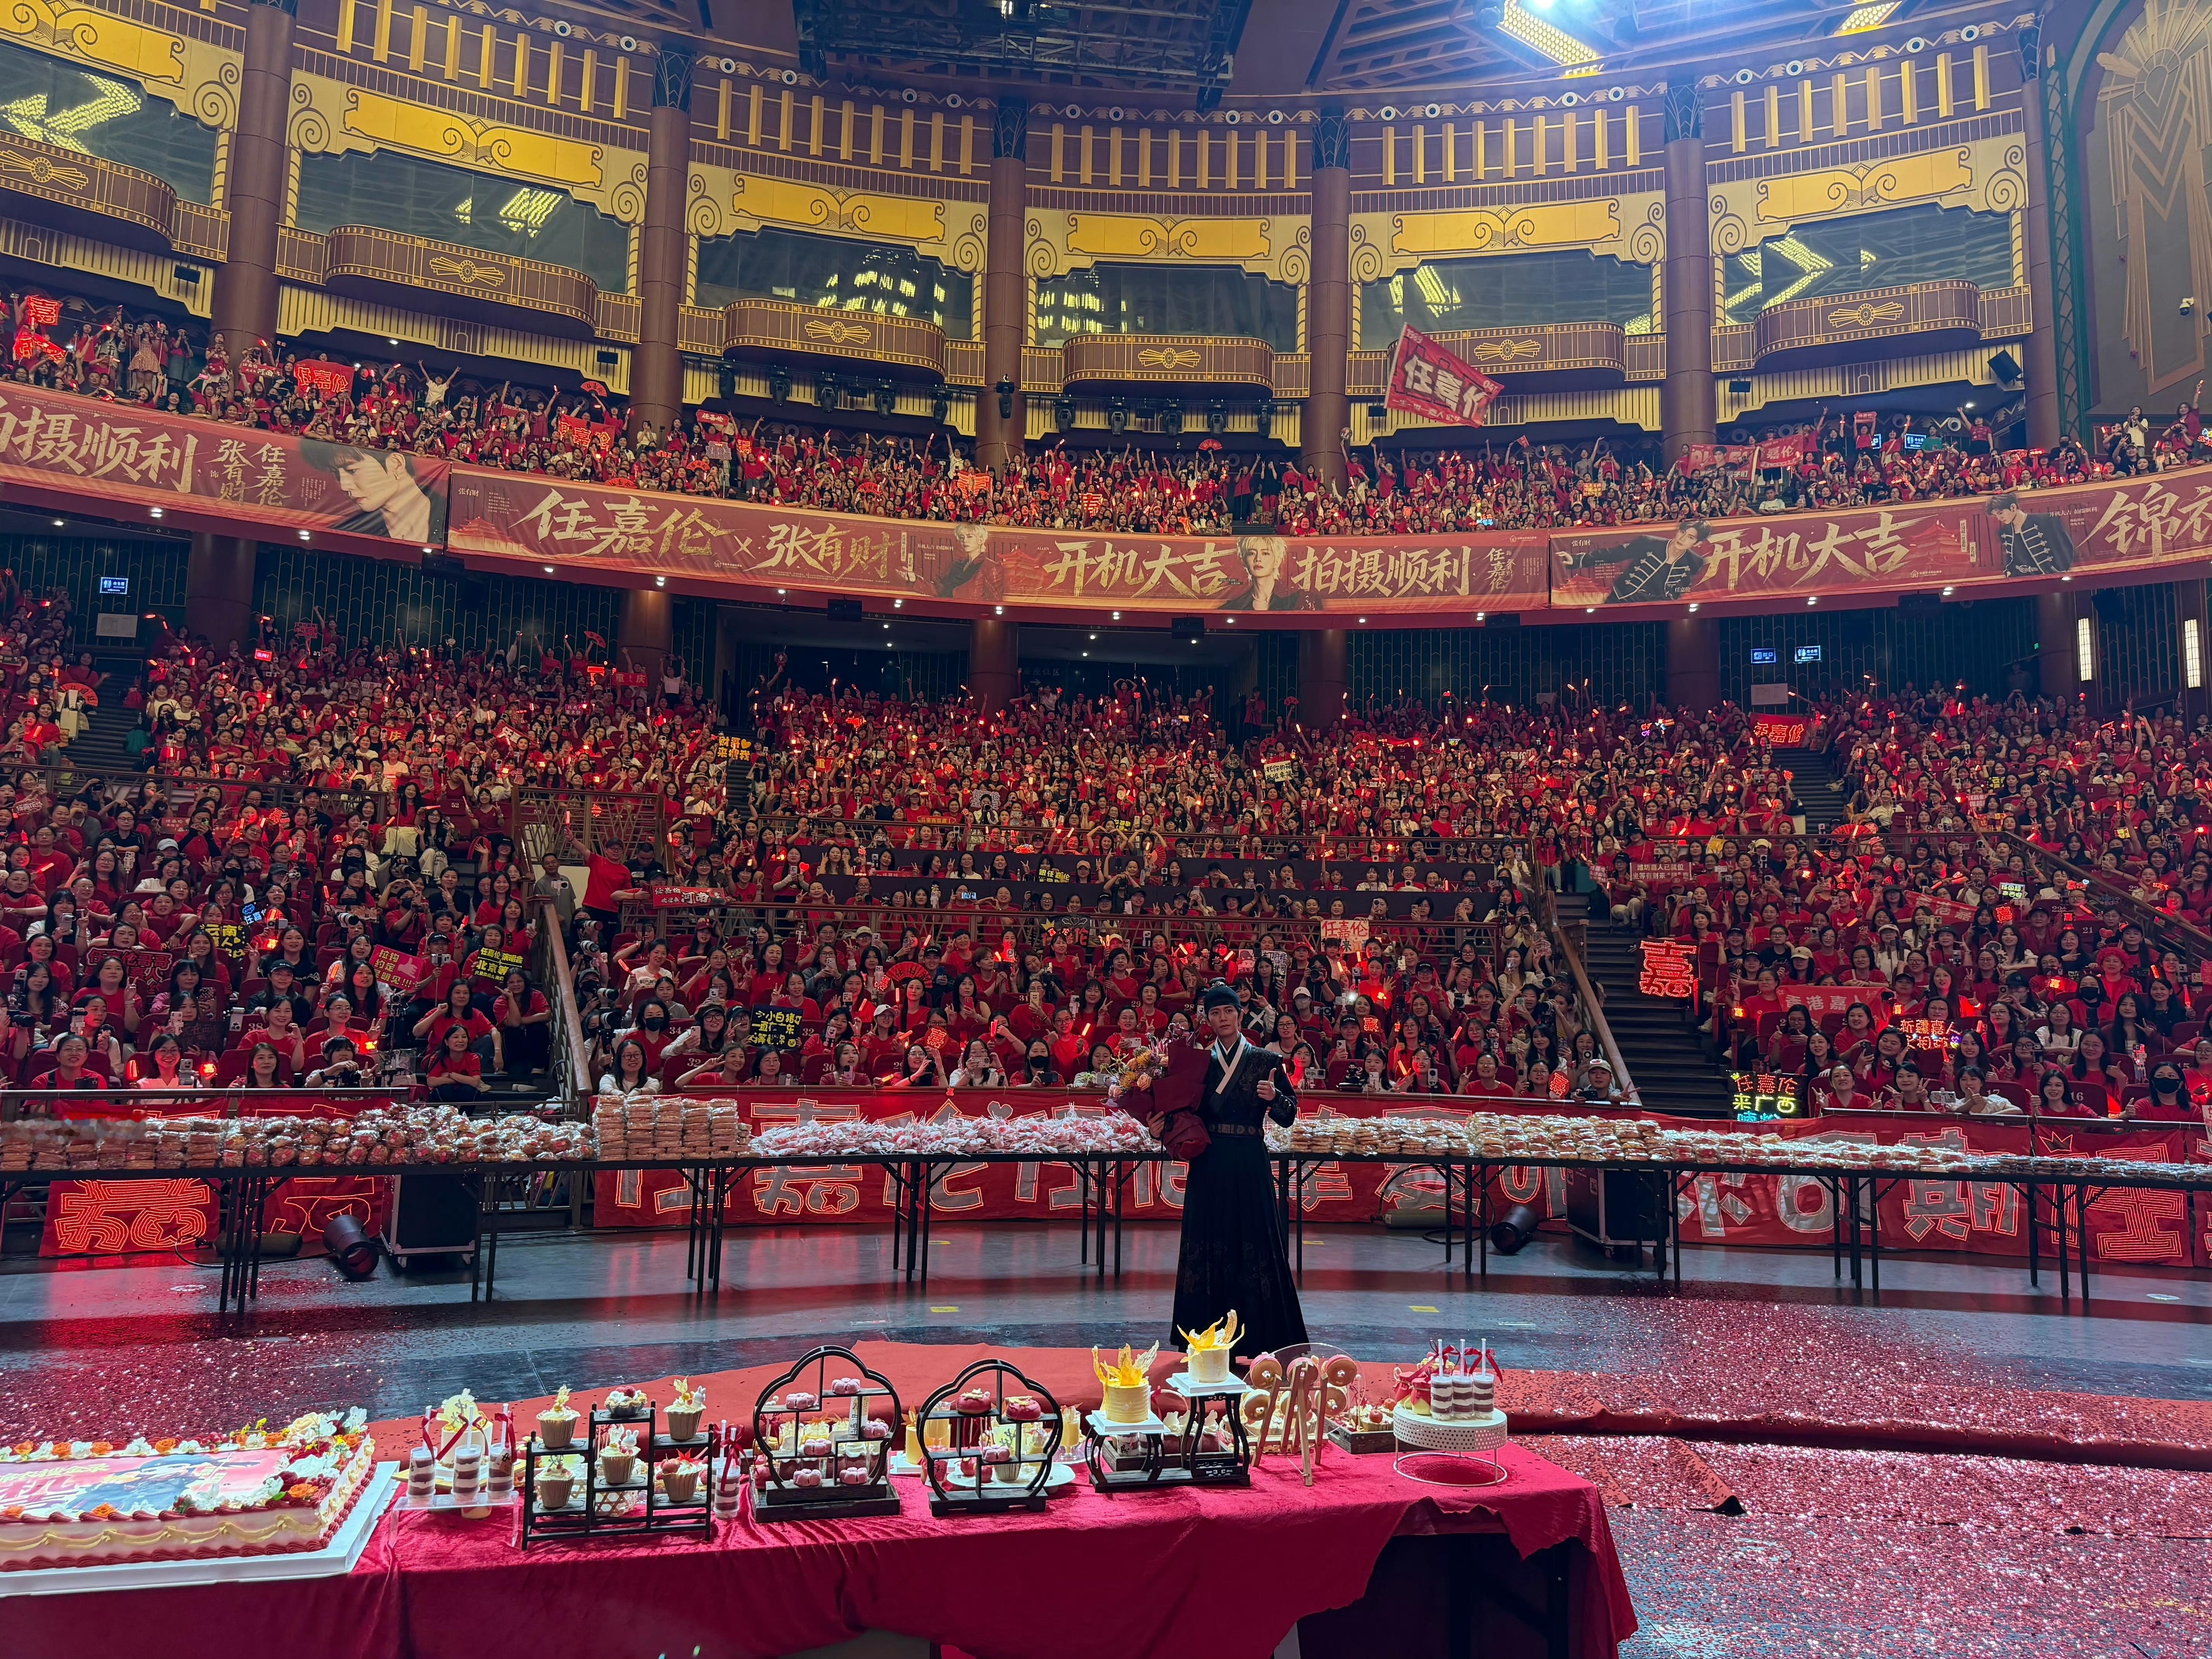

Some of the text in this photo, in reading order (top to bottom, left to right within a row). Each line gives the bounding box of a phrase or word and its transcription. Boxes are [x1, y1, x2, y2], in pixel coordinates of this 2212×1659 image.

[206, 439, 256, 505] 张有财
[250, 442, 292, 508] 任嘉伦
[2076, 482, 2212, 558] 锦衣
[508, 488, 746, 565] 任嘉伦
[744, 520, 899, 582] 张有财
[1695, 512, 1936, 590] 开机大吉
[1042, 540, 1237, 599] 开机大吉
[1291, 546, 1477, 598] 拍摄顺利
[1485, 547, 1506, 591] 任嘉伦
[719, 736, 740, 749] 财哥
[681, 891, 709, 904] 河南
[1321, 921, 1368, 938] 任嘉伦
[376, 959, 396, 973] 约定
[378, 948, 400, 963] 拉钩
[1640, 940, 1697, 998] 嘉
[765, 1011, 795, 1024] 小白猪
[1899, 1019, 1962, 1035] 新疆嘉人
[669, 1027, 682, 1035] 34
[687, 1058, 701, 1067] 32
[823, 1063, 835, 1072] 30
[1735, 1073, 1798, 1096] 任嘉伦
[1732, 1092, 1796, 1113] 来广西
